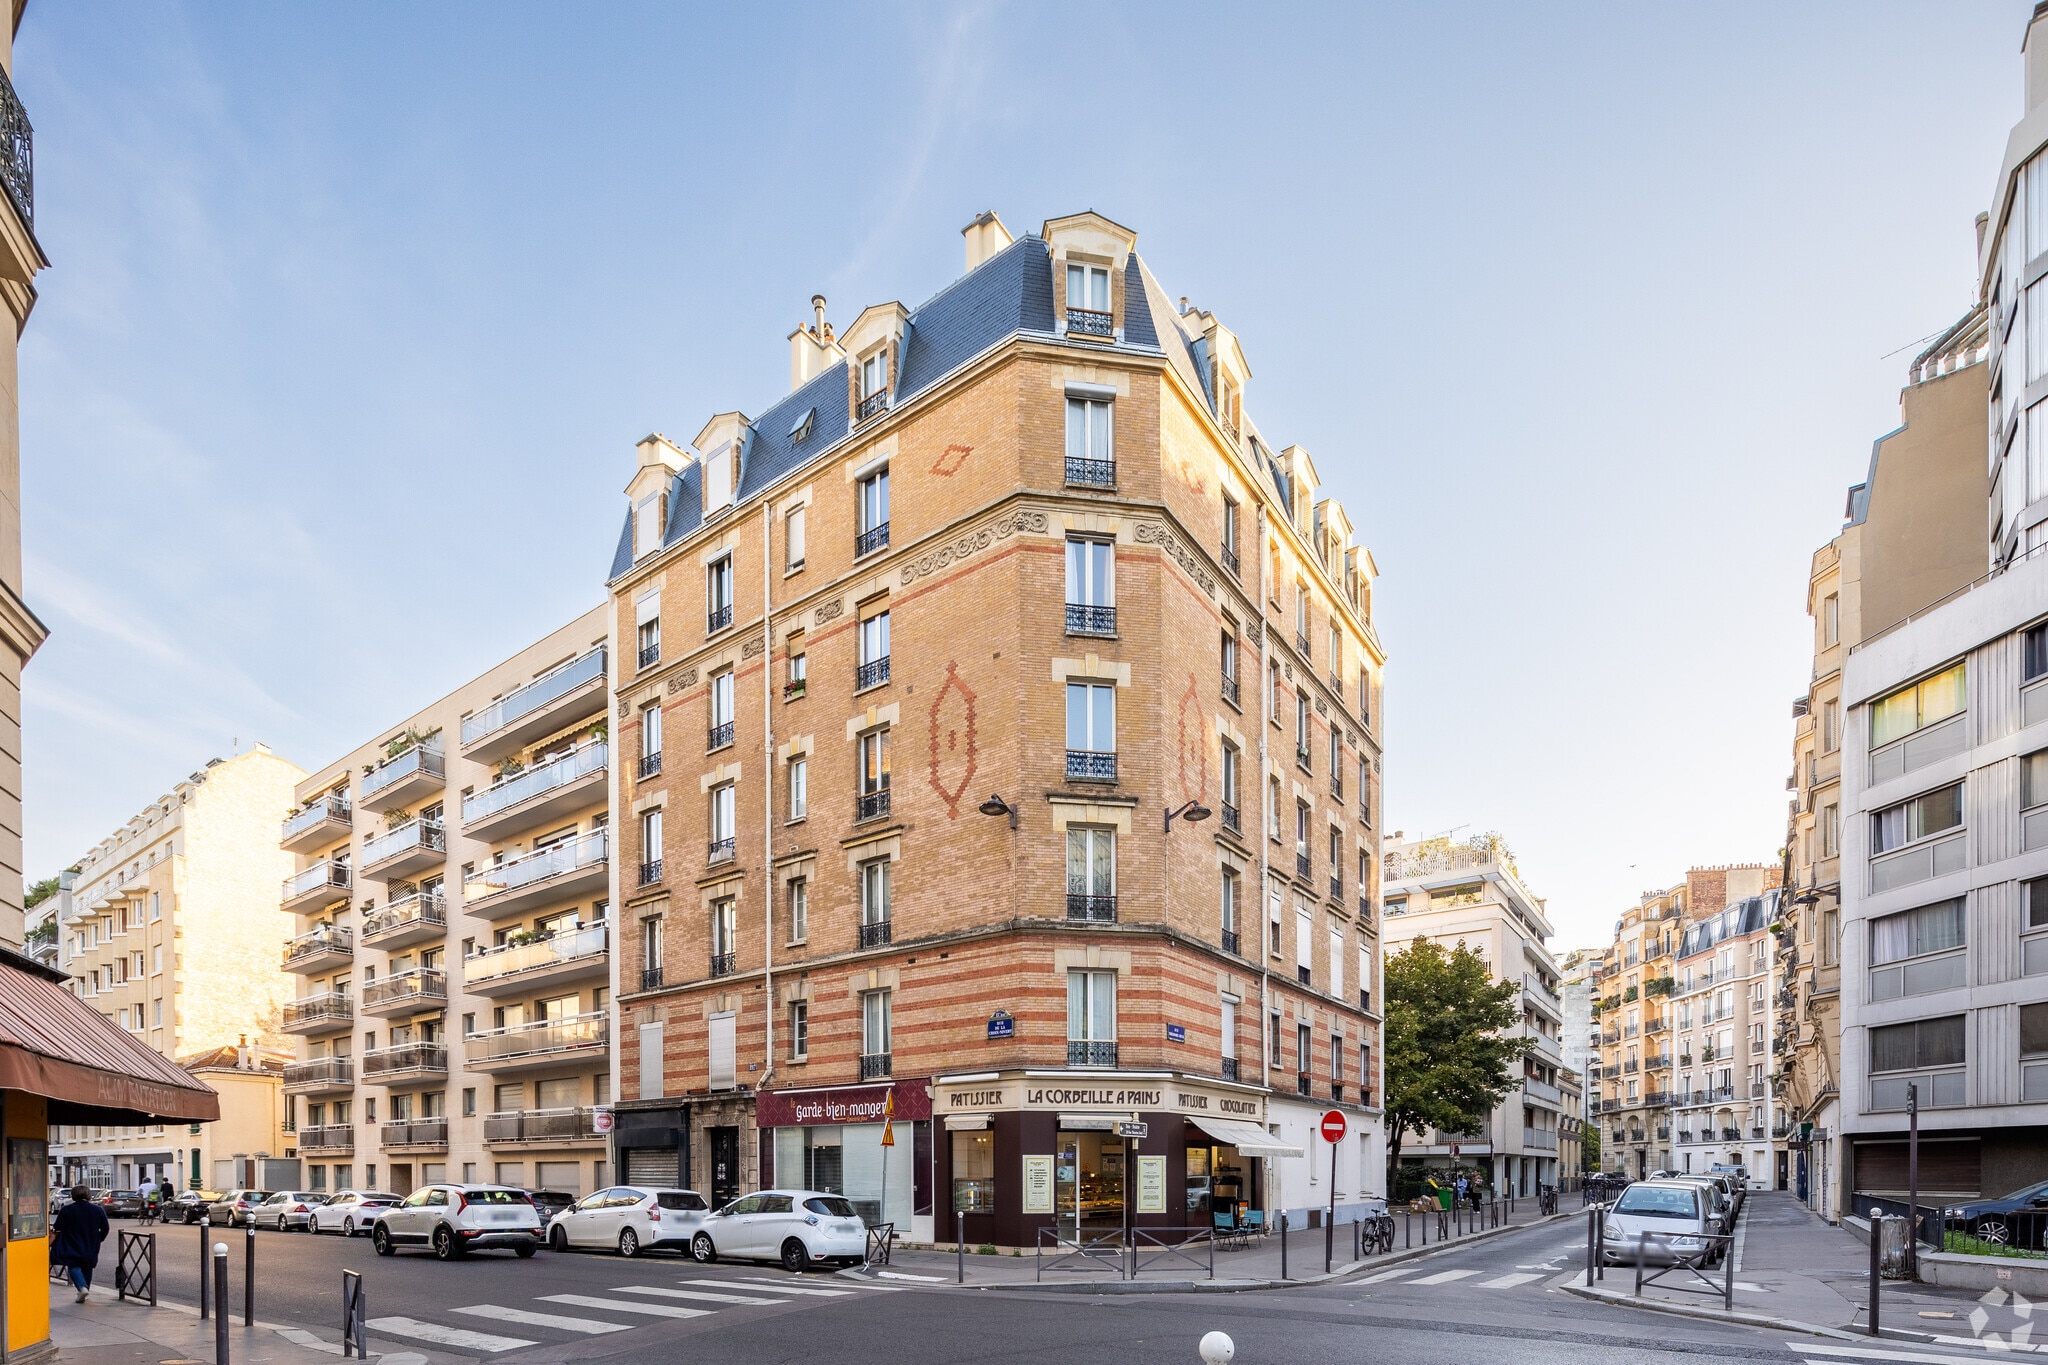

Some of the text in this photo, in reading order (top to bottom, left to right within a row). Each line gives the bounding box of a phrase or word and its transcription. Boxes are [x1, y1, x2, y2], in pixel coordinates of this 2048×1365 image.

[97, 1076, 176, 1112] ALIMENTATION
[950, 1090, 1003, 1107] PATISSIER
[1027, 1089, 1161, 1105] LA CORBEILLE A PAINS
[1178, 1093, 1257, 1115] PATISSIER CHOCOLATIER
